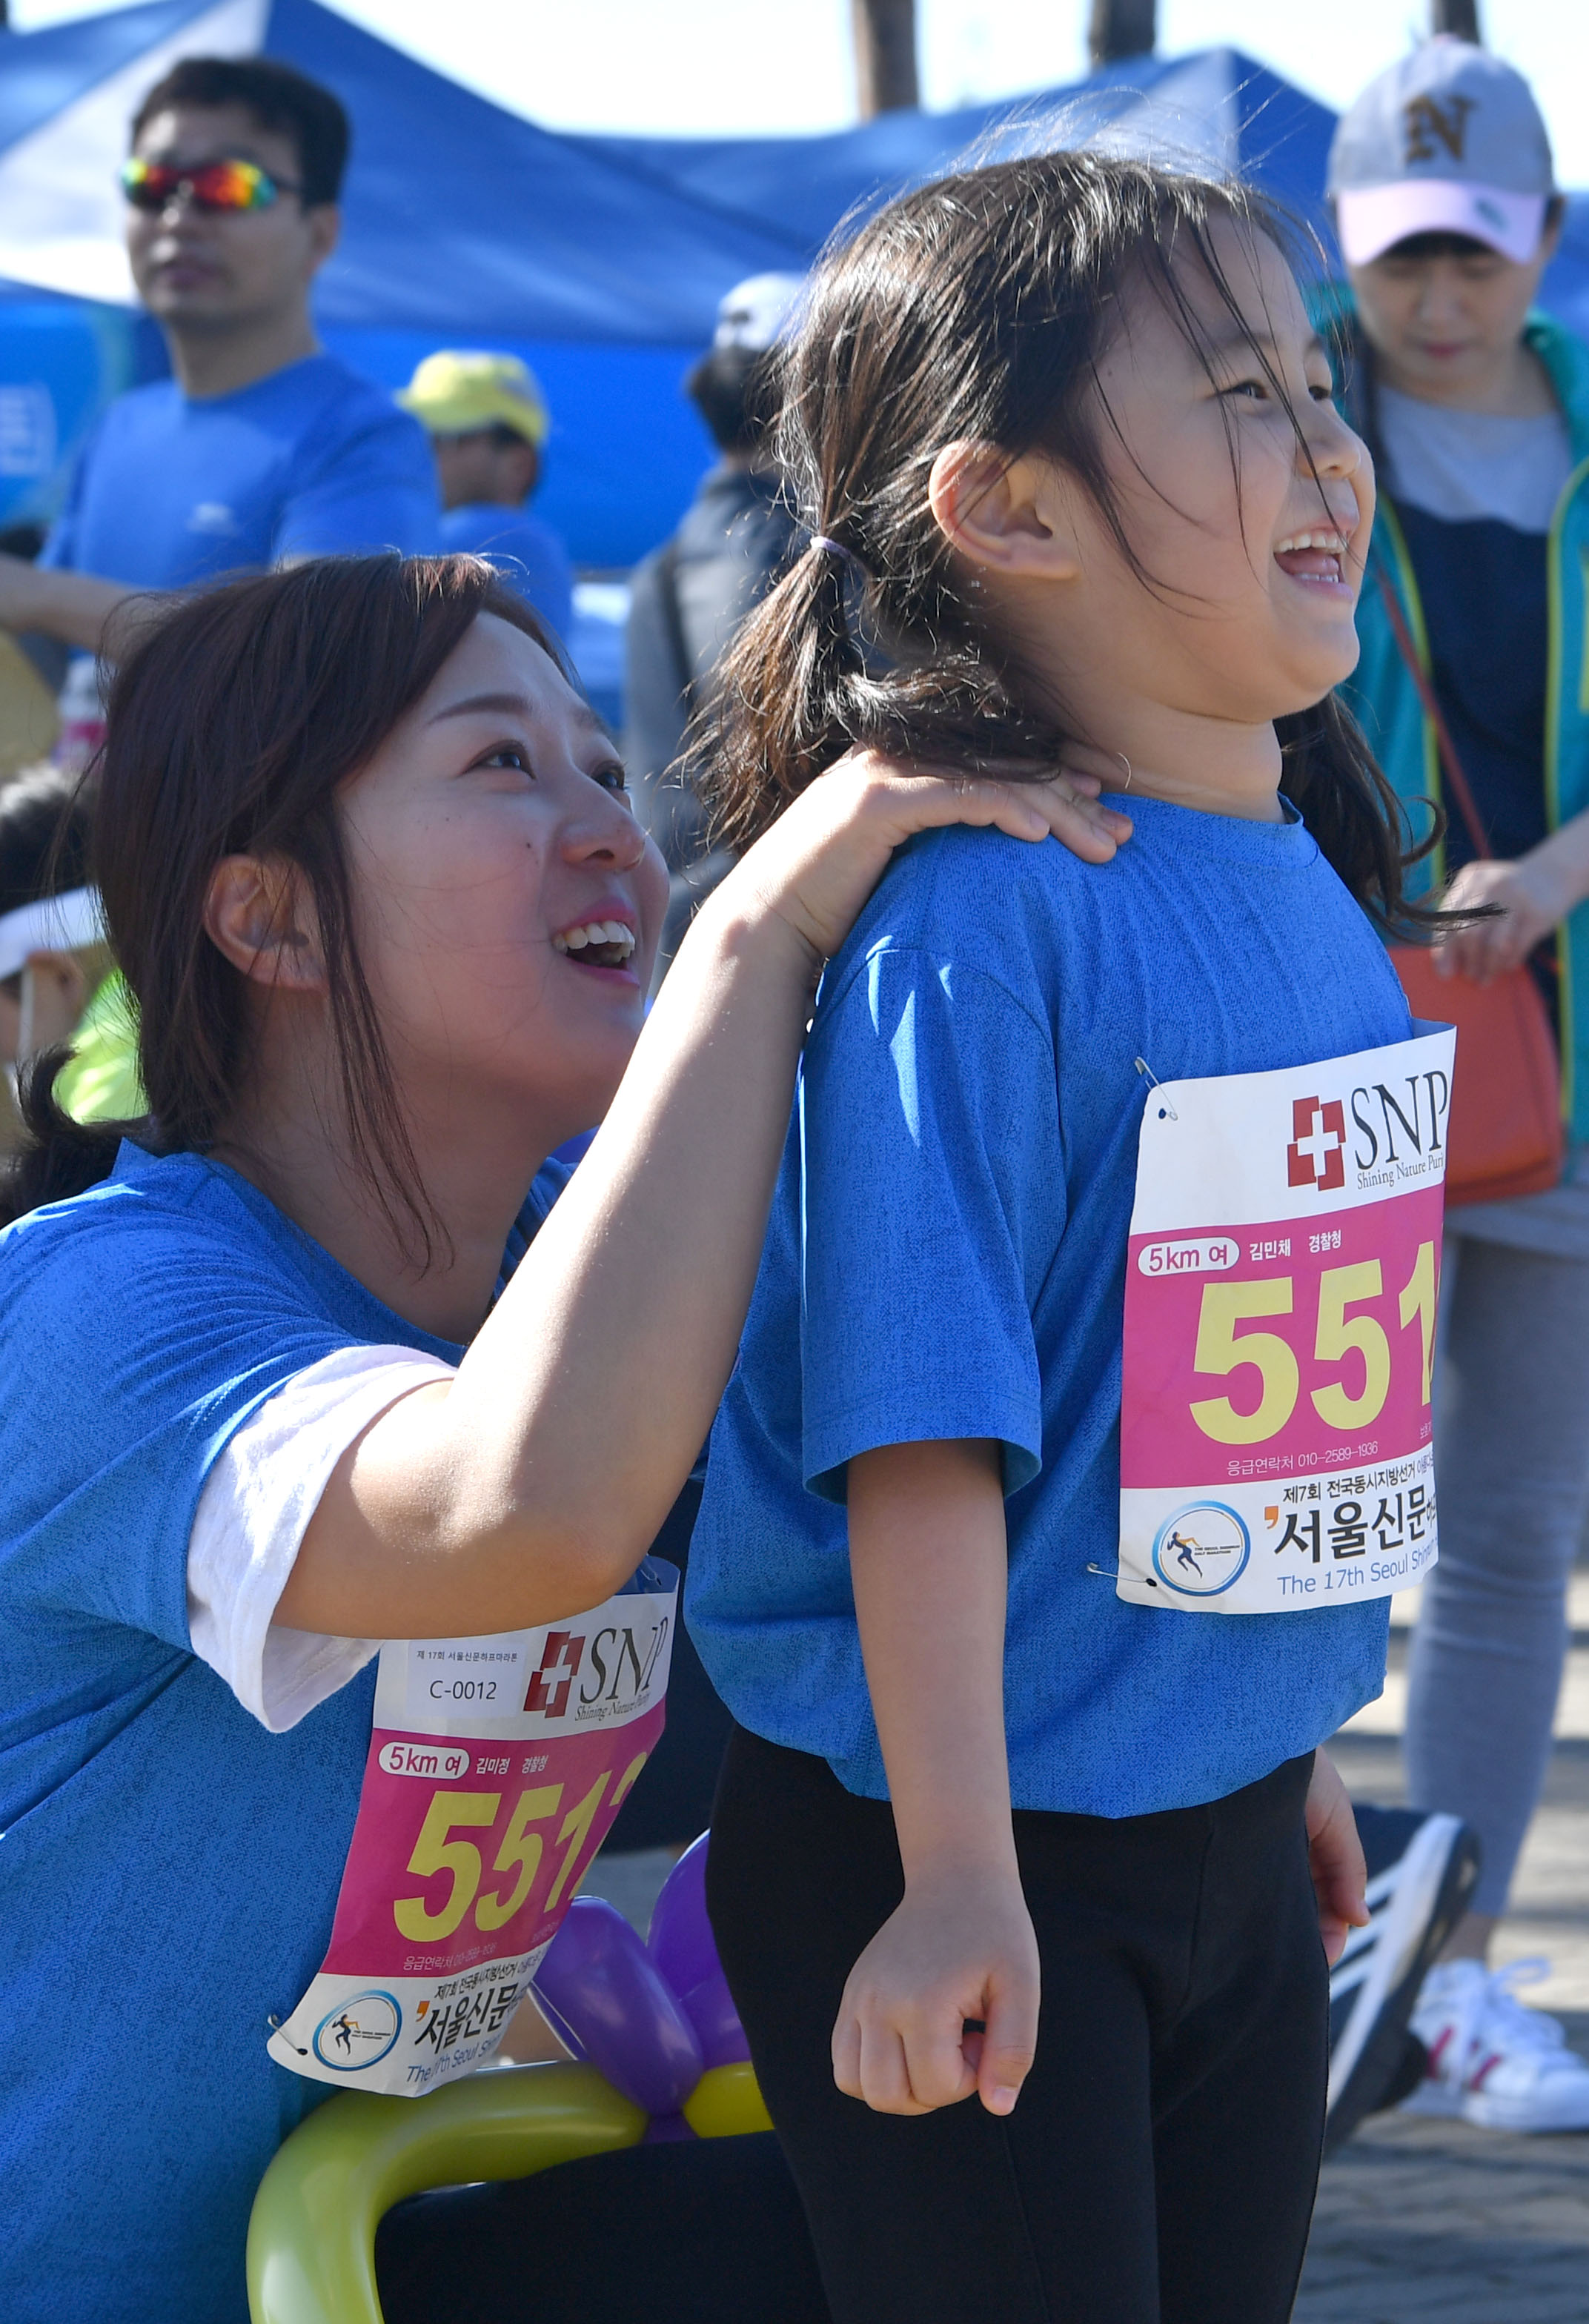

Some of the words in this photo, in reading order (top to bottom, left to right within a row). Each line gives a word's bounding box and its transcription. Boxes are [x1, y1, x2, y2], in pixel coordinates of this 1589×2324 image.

[1351, 1071, 1447, 1170] SNP
[1358, 1169, 1394, 1189] Shining
[1396, 1162, 1426, 1180] Nature
[1149, 1246, 1199, 1272] 5km
[1209, 1244, 1227, 1265] 여
[1250, 1238, 1291, 1261] 김민채
[1309, 1229, 1341, 1253] 경찰청
[1189, 1241, 1440, 1445] 551
[1227, 1455, 1294, 1476] 응급연락처
[1283, 1482, 1321, 1504] 제7회
[1326, 1462, 1416, 1498] 전국동시지방선거
[1277, 1575, 1316, 1595] The
[1324, 1566, 1364, 1589] 17th
[1370, 1553, 1408, 1582] Seoul
[417, 1650, 425, 1659] 제
[428, 1651, 445, 1660] 17회
[580, 1616, 668, 1704] SNP
[430, 1680, 497, 1699] C-0012
[575, 1704, 608, 1722] Shining
[389, 1746, 438, 1773] 5km
[445, 1756, 462, 1776] 여
[476, 1757, 511, 1775] 김미정
[407, 2062, 431, 2083] The
[451, 2042, 480, 2068] Seoul
